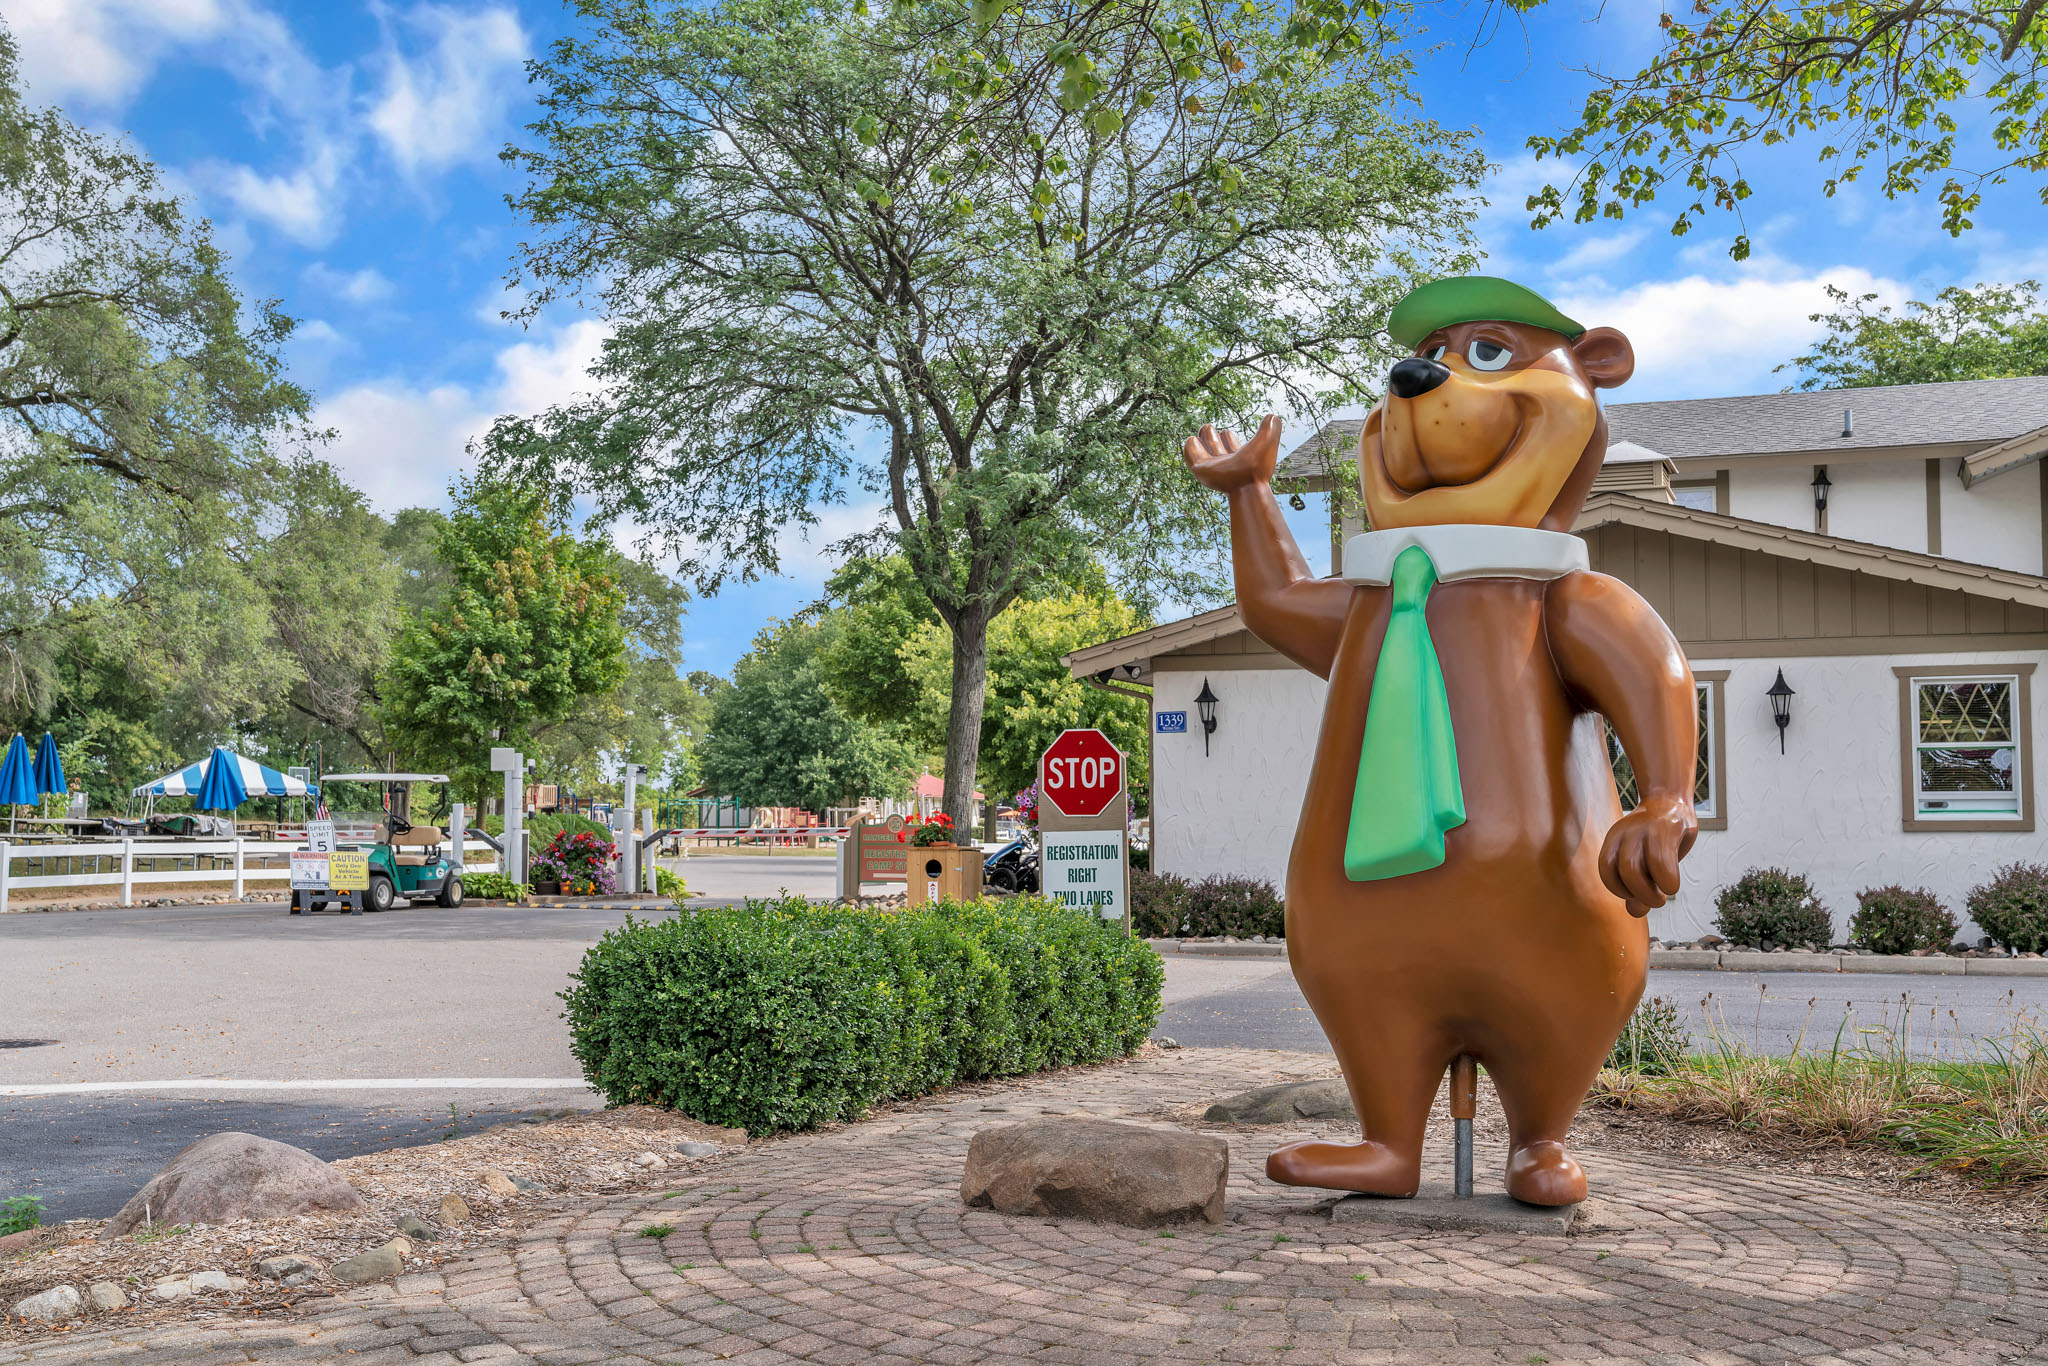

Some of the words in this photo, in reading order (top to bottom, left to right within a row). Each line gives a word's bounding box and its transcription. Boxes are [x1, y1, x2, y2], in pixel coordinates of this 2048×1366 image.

[1159, 714, 1184, 727] 1339
[1048, 757, 1116, 789] STOP
[317, 841, 328, 852] 5
[1047, 845, 1119, 861] REGISTRATION
[867, 861, 893, 870] CAMP
[1068, 868, 1097, 883] RIGHT
[1053, 891, 1077, 905] TWO
[1080, 890, 1114, 906] LANES
